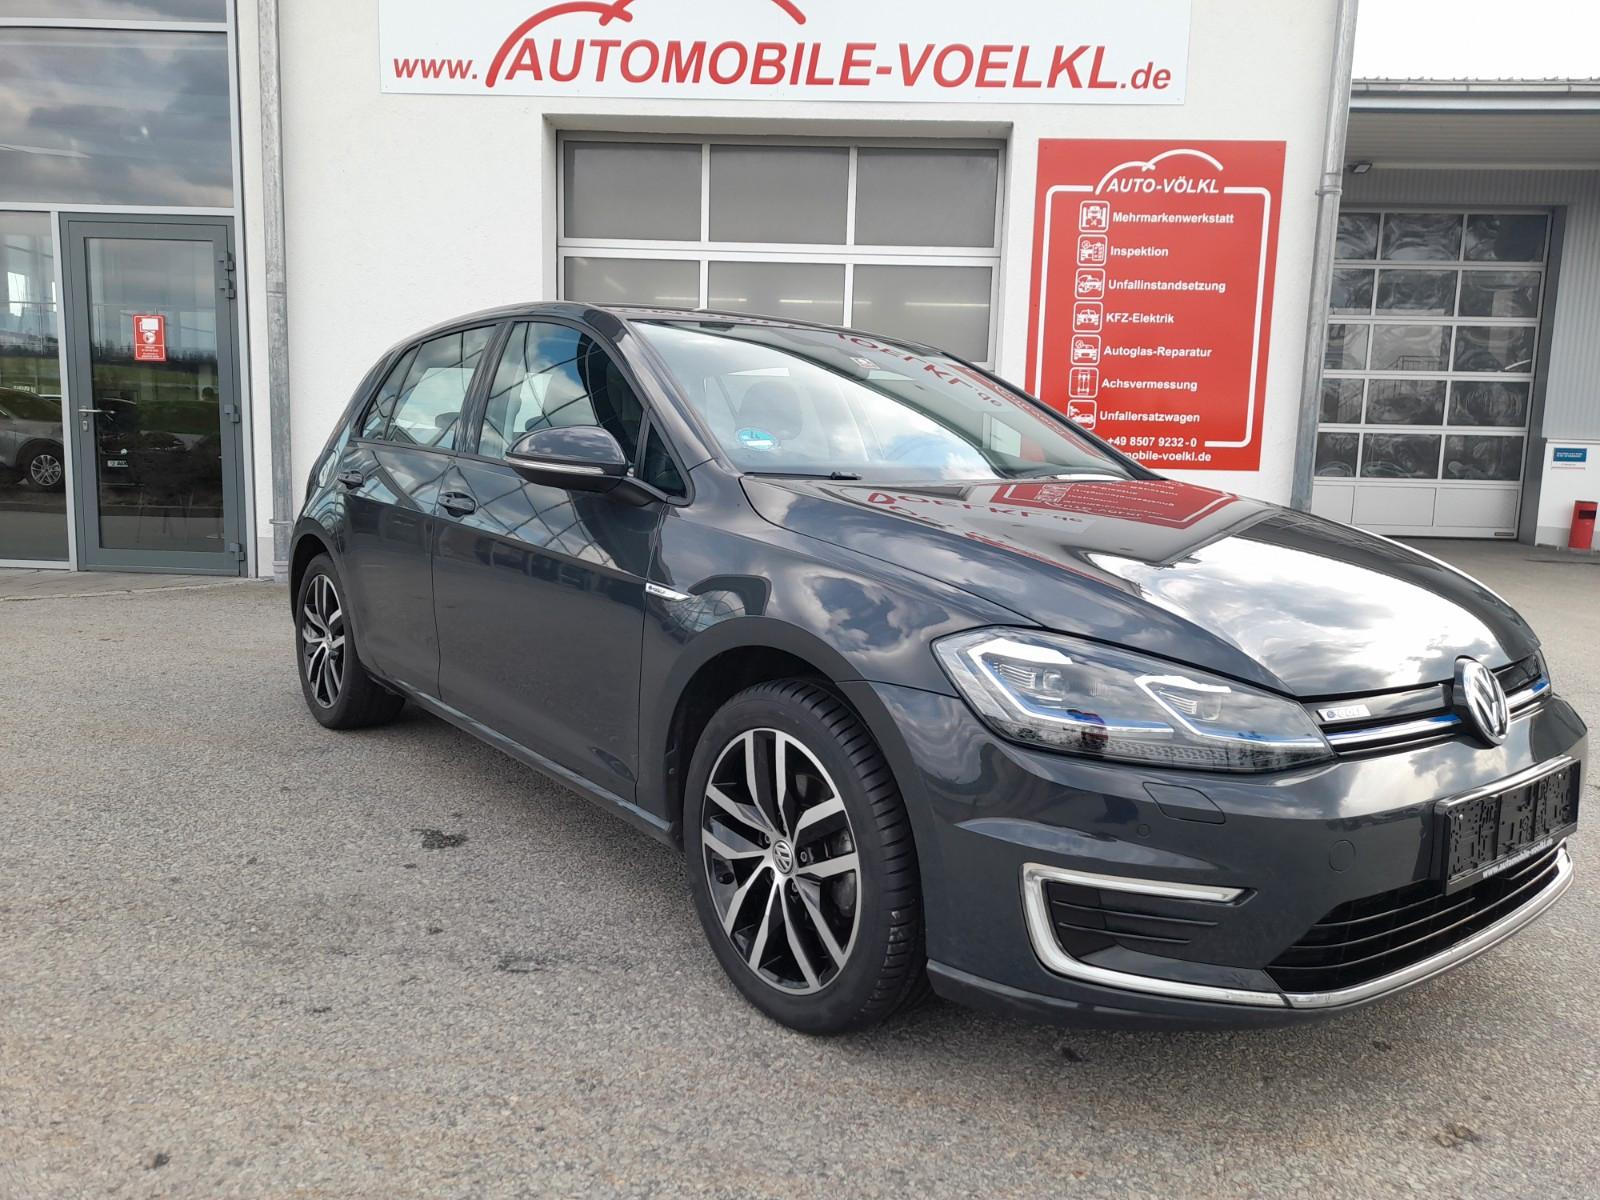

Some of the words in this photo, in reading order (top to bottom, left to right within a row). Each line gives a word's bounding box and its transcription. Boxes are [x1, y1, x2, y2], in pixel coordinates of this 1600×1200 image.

[1107, 177, 1219, 194] AUTO-VÖLKL
[1113, 211, 1234, 225] Mehrmarkenwerkstatt
[1110, 246, 1169, 258] Inspektion
[1108, 279, 1226, 294] Unfallinstandsetzung
[1106, 313, 1175, 324] KFZ-Elektrik
[1103, 345, 1212, 359] Autoglas-Reparatur
[1101, 379, 1198, 393] Achsvermessung
[1099, 411, 1200, 424] Unfallersatzwagen
[1107, 436, 1127, 446] +49
[1129, 437, 1155, 446] 8507
